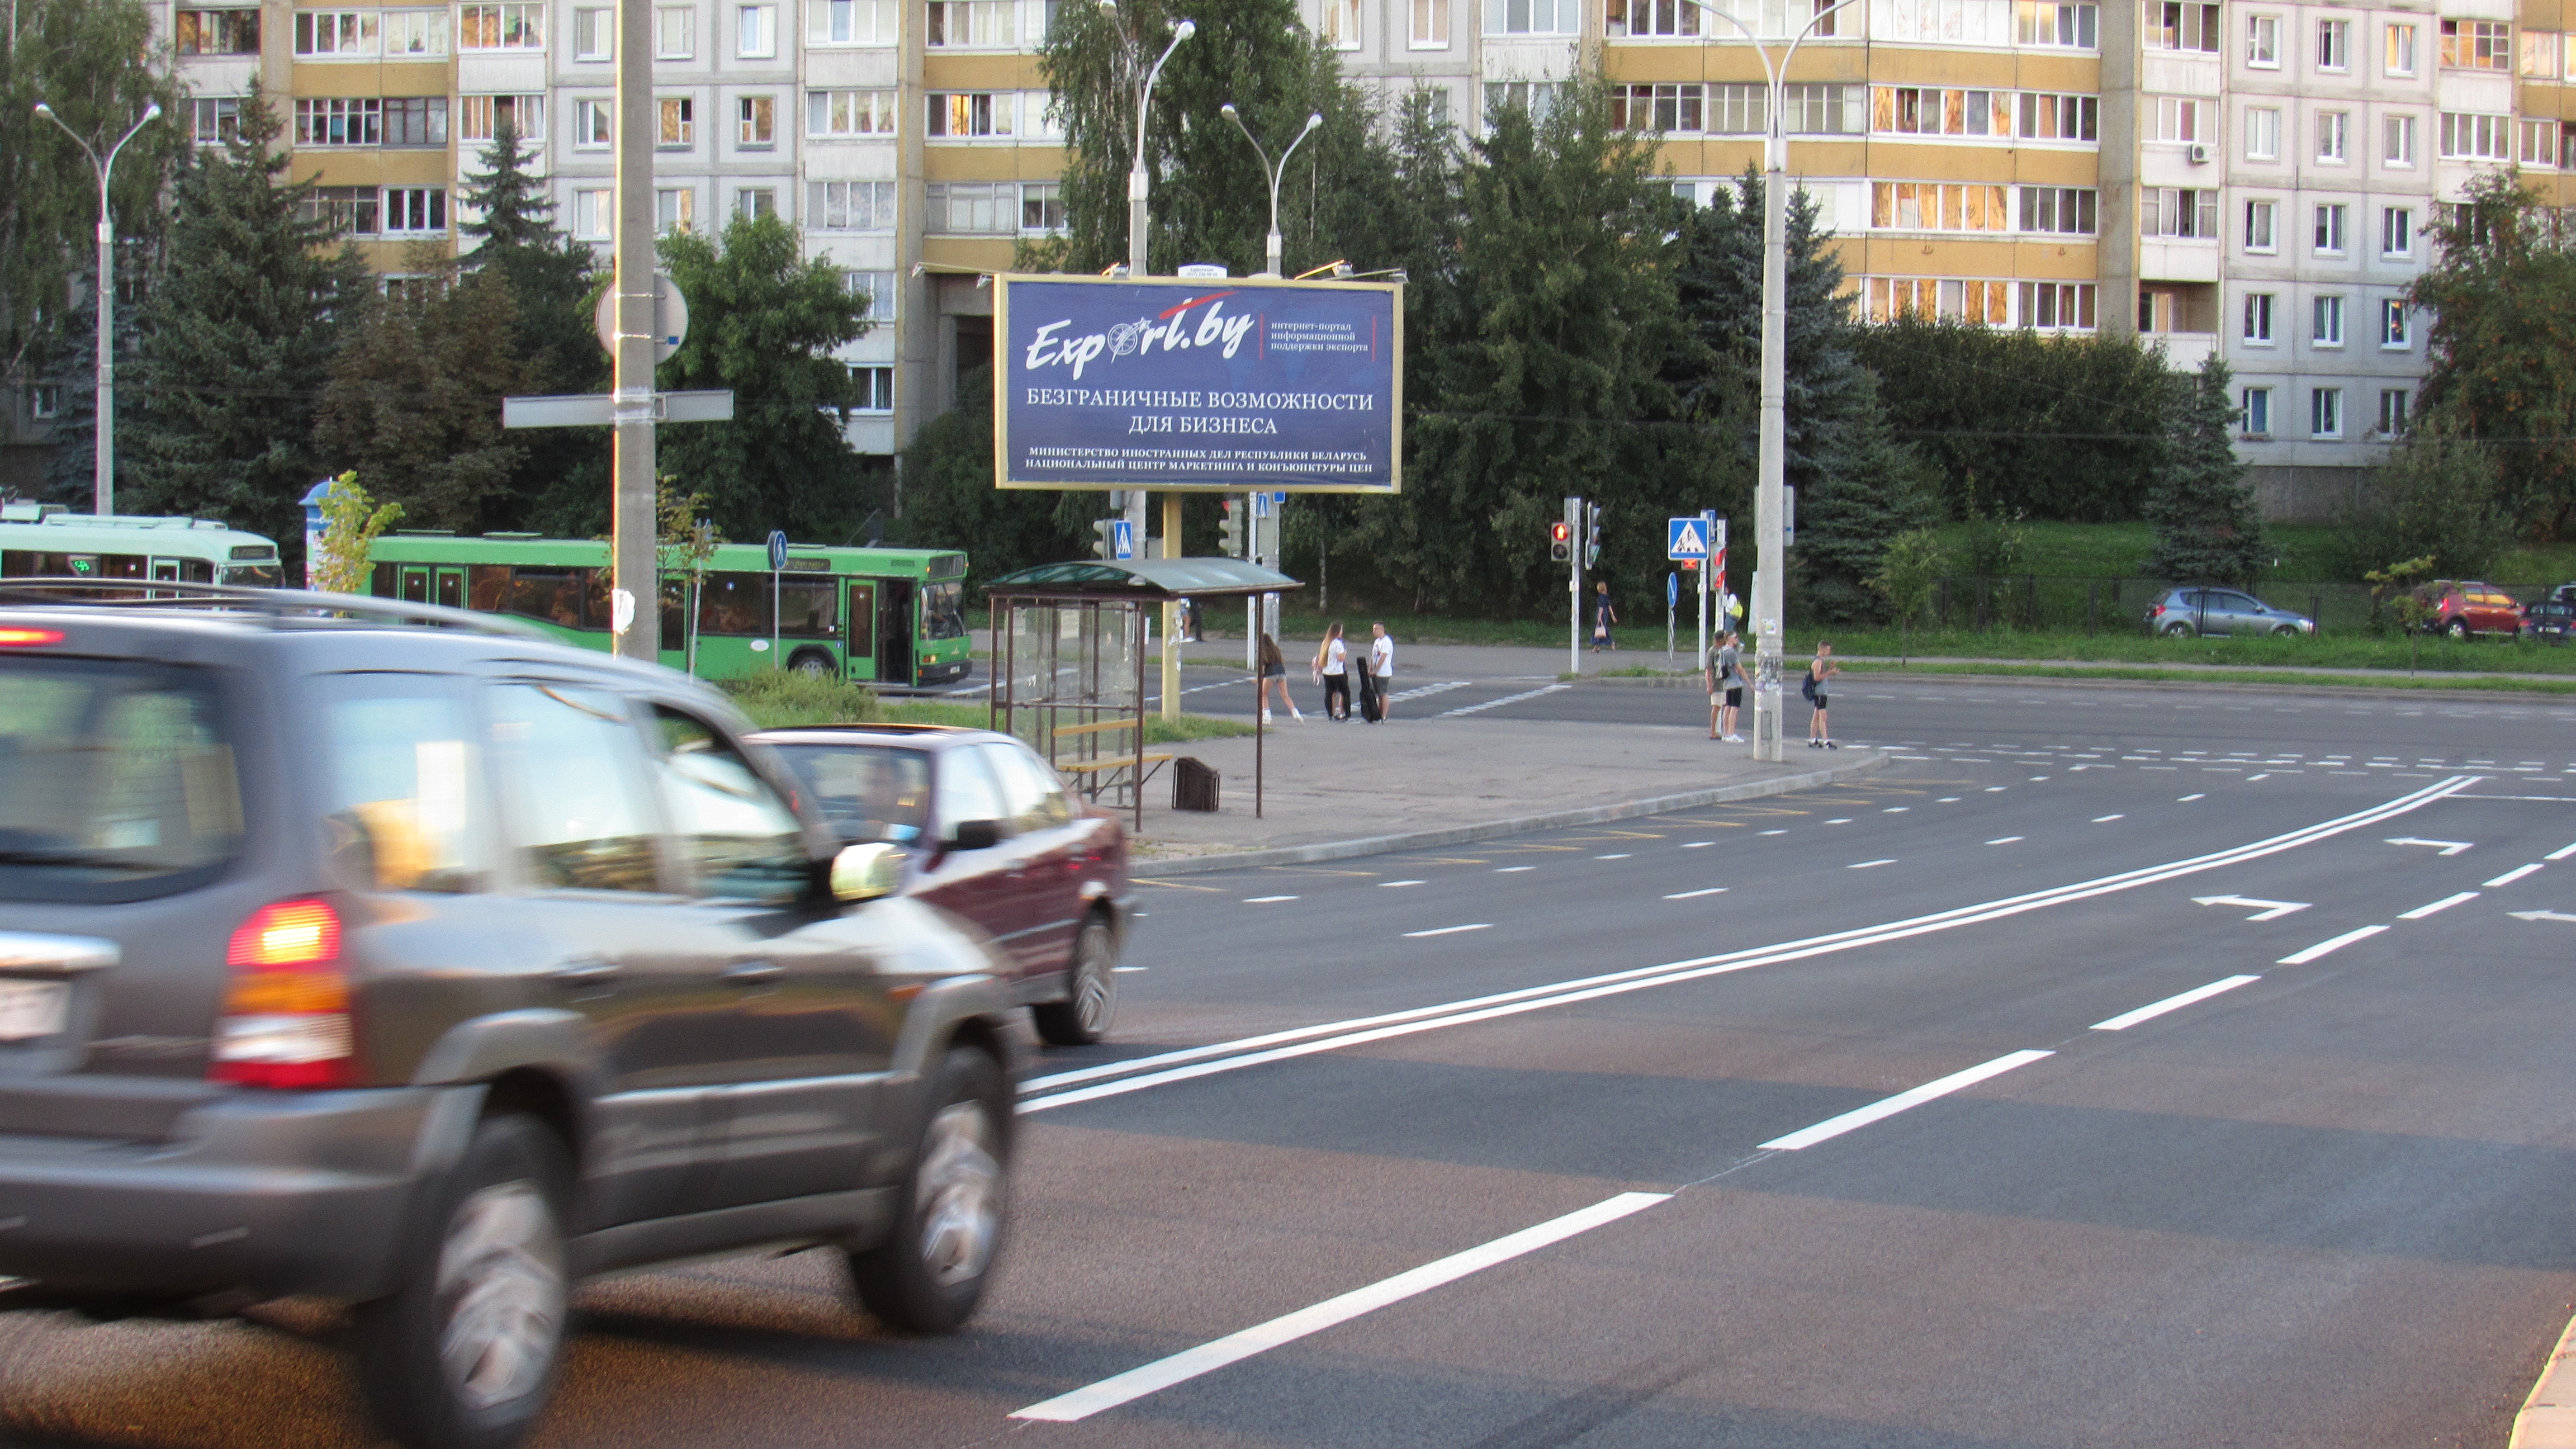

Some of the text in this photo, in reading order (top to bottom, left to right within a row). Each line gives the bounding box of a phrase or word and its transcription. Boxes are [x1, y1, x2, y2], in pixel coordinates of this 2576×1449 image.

[1271, 323, 1351, 332] интернет-портал
[1026, 291, 1255, 380] Export.by
[1271, 332, 1355, 342] информационной
[1271, 342, 1368, 353] поддержки экспорта
[1026, 388, 1374, 411] БЕЗГРАНИЧНЫЕ ВОЗМОЖНОСТИ
[1129, 416, 1278, 434] ДЛЯ БИЗНЕСА
[1029, 447, 1367, 461] МИНИСТЕРСТВО ИНОСТРАННЫХ ДЕЛ РЕСПУБЛИКИ БЕЛАРУСЬ
[1025, 458, 1372, 474] НАЦИОНАЛЬНЫЙ ЦЕНТР МАРКЕТИНГА И КОНЪЮНКТУРЫ ЦЕН
